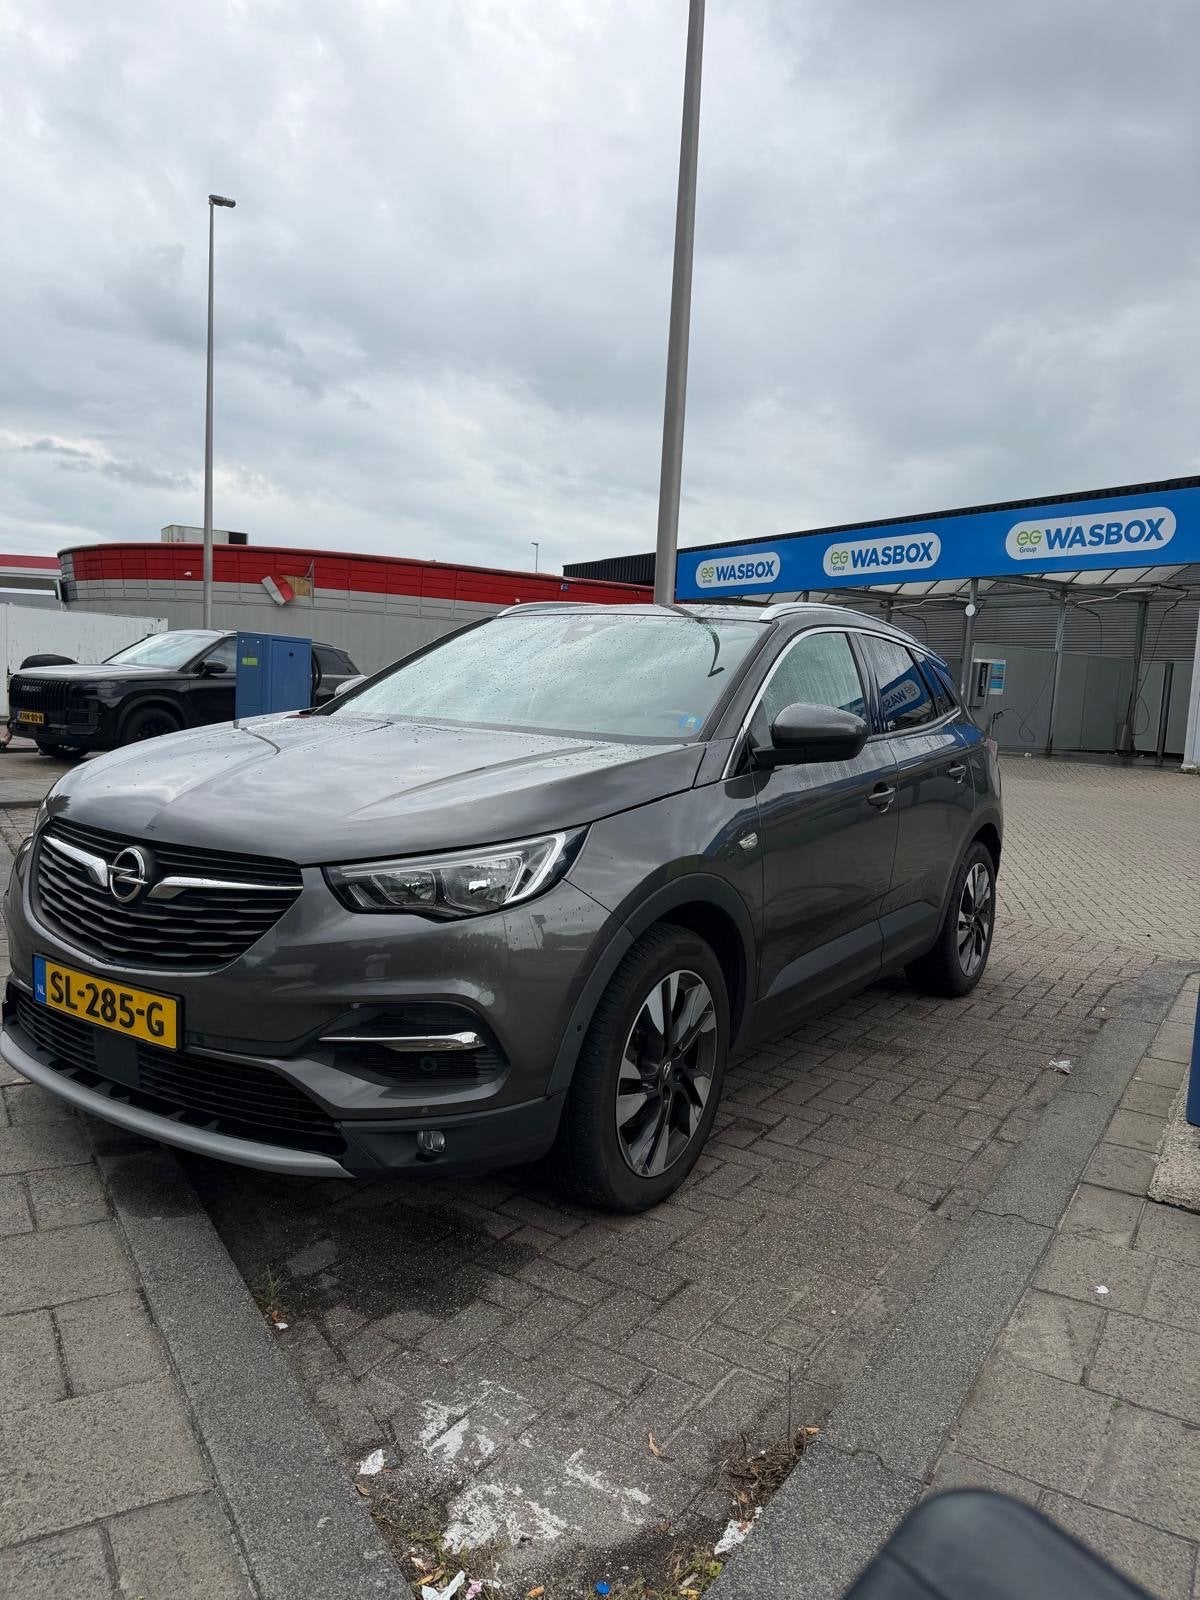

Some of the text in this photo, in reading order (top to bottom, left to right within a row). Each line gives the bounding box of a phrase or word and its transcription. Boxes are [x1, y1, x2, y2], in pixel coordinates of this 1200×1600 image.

[1045, 517, 1166, 550] WASBOX
[851, 541, 934, 569] WASBOX
[1019, 545, 1037, 554] Group
[715, 560, 776, 582] WASBOX
[37, 970, 165, 1037] NL SL-285-G
